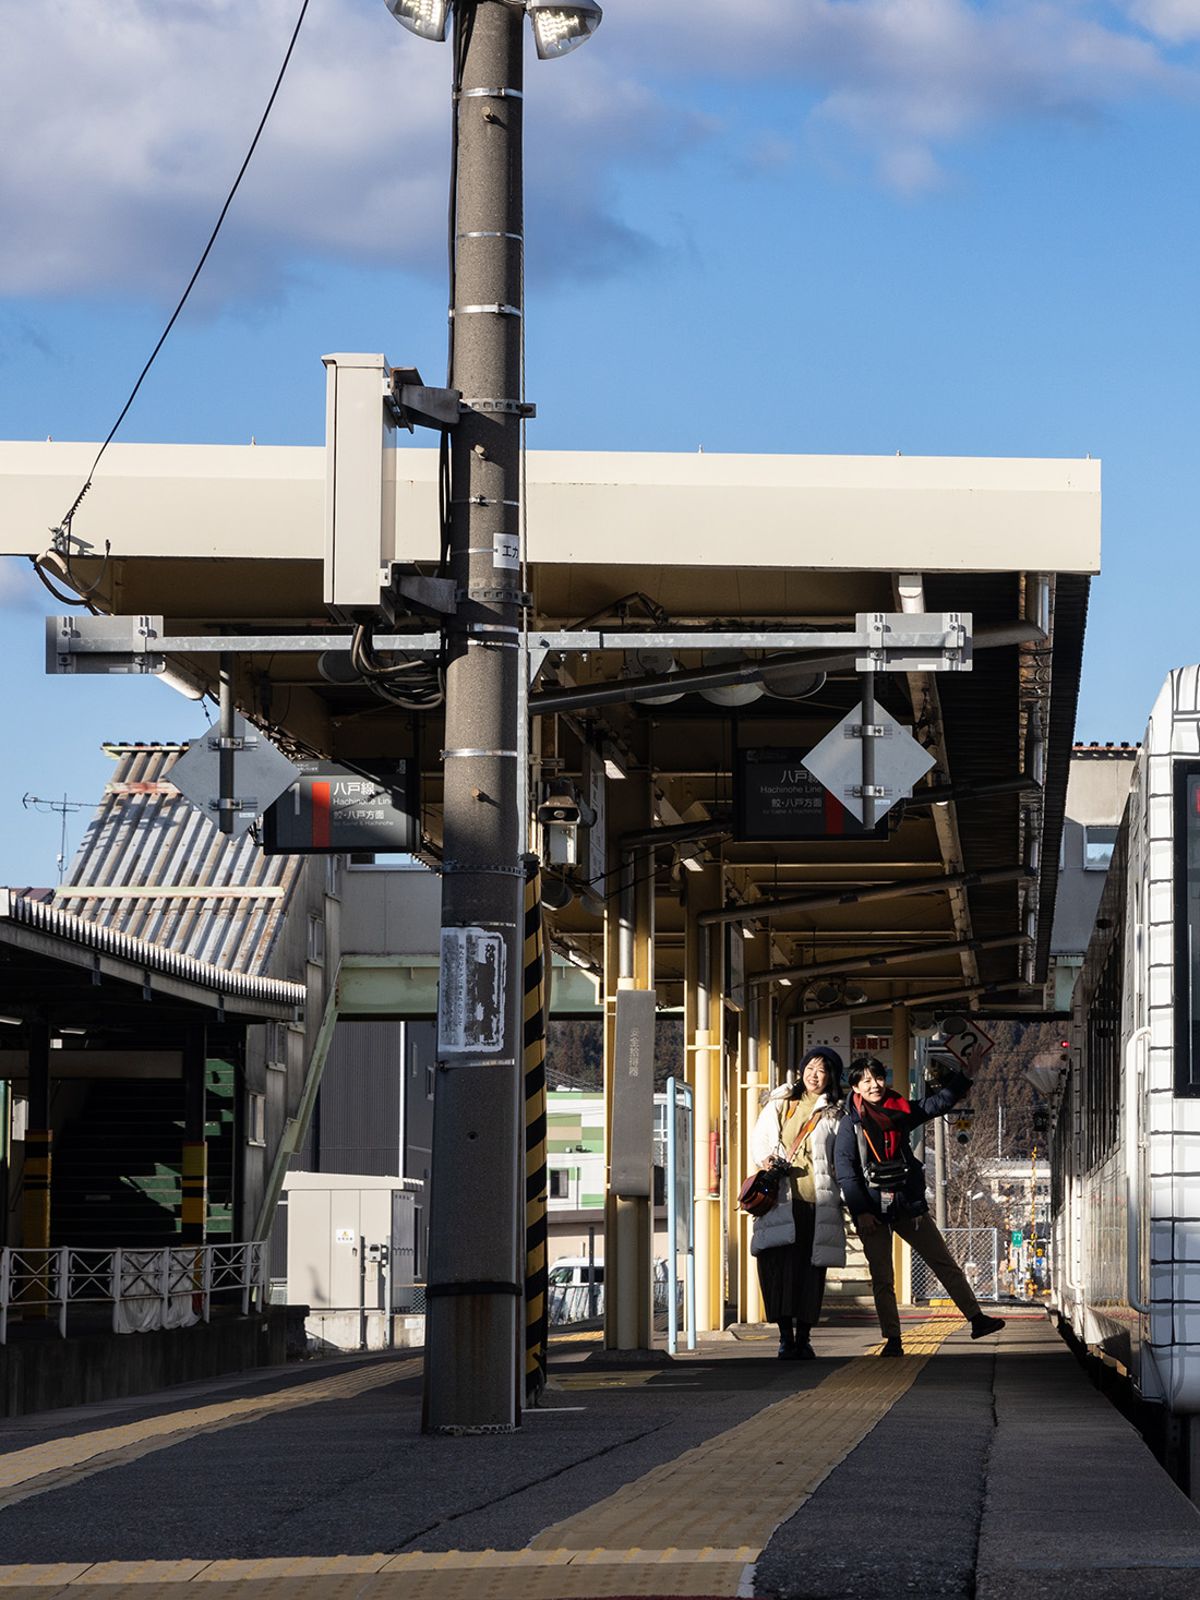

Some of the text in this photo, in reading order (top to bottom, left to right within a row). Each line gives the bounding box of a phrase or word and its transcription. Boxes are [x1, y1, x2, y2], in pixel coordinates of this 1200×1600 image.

[333, 782, 375, 796] 八戸線
[760, 785, 803, 794] Hachinohe
[960, 1031, 978, 1058] 2
